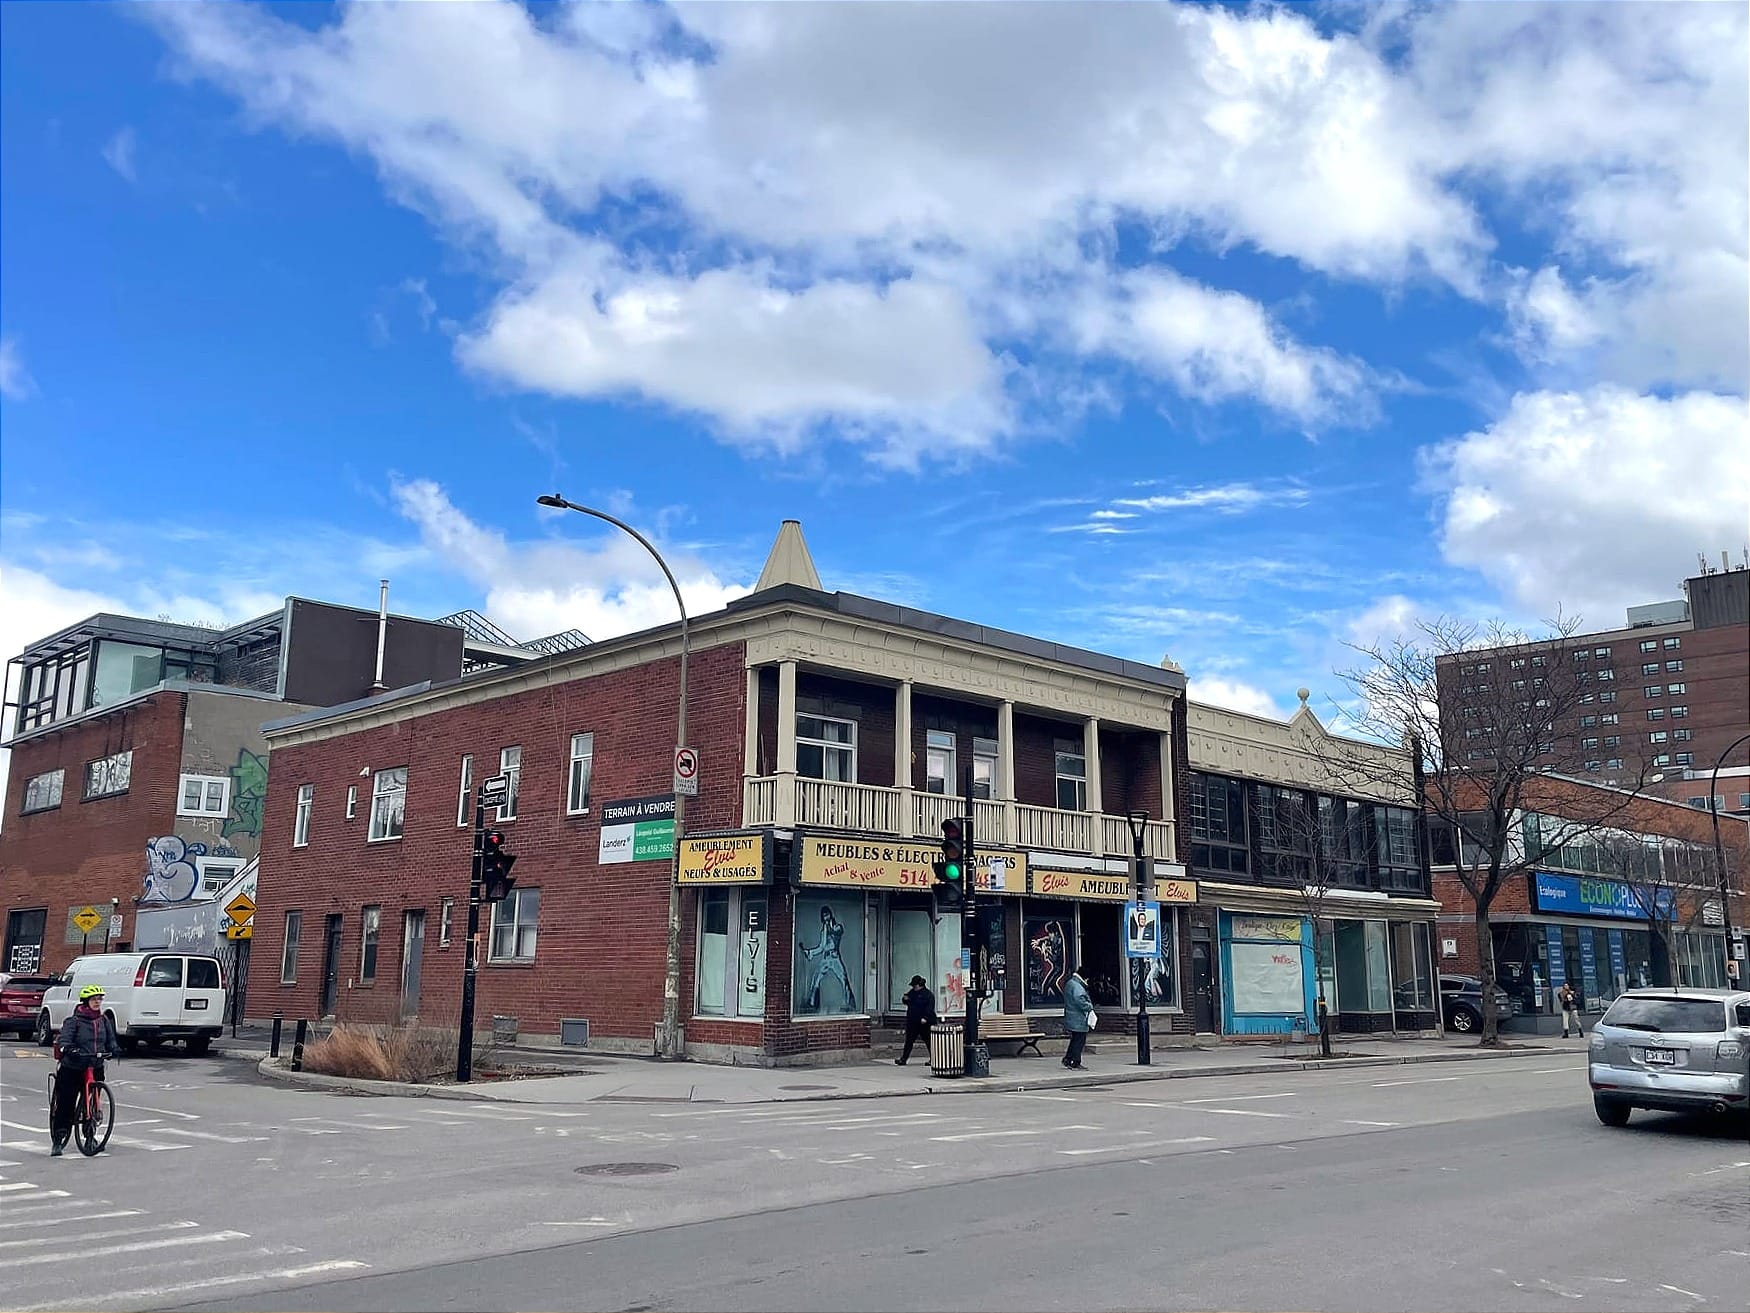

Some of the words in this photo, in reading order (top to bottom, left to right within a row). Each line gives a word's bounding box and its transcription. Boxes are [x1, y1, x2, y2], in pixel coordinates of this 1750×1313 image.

[604, 805, 636, 819] TERRAIN
[636, 802, 643, 815] À
[644, 800, 676, 814] VENDRE
[689, 839, 754, 853] AMEUBLEMENT
[816, 843, 879, 860] MEUBLES
[882, 848, 894, 861] &
[703, 848, 737, 872] Elvis
[683, 868, 711, 879] NEUFS
[712, 868, 721, 878] &
[722, 863, 757, 878] USAGÉS
[823, 861, 849, 879] Achat
[849, 868, 858, 880] &
[859, 866, 886, 882] Vente
[899, 869, 929, 886] 514
[1042, 873, 1070, 893] Elvis
[1166, 882, 1190, 901] Elvis
[746, 911, 760, 993] ELVIS
